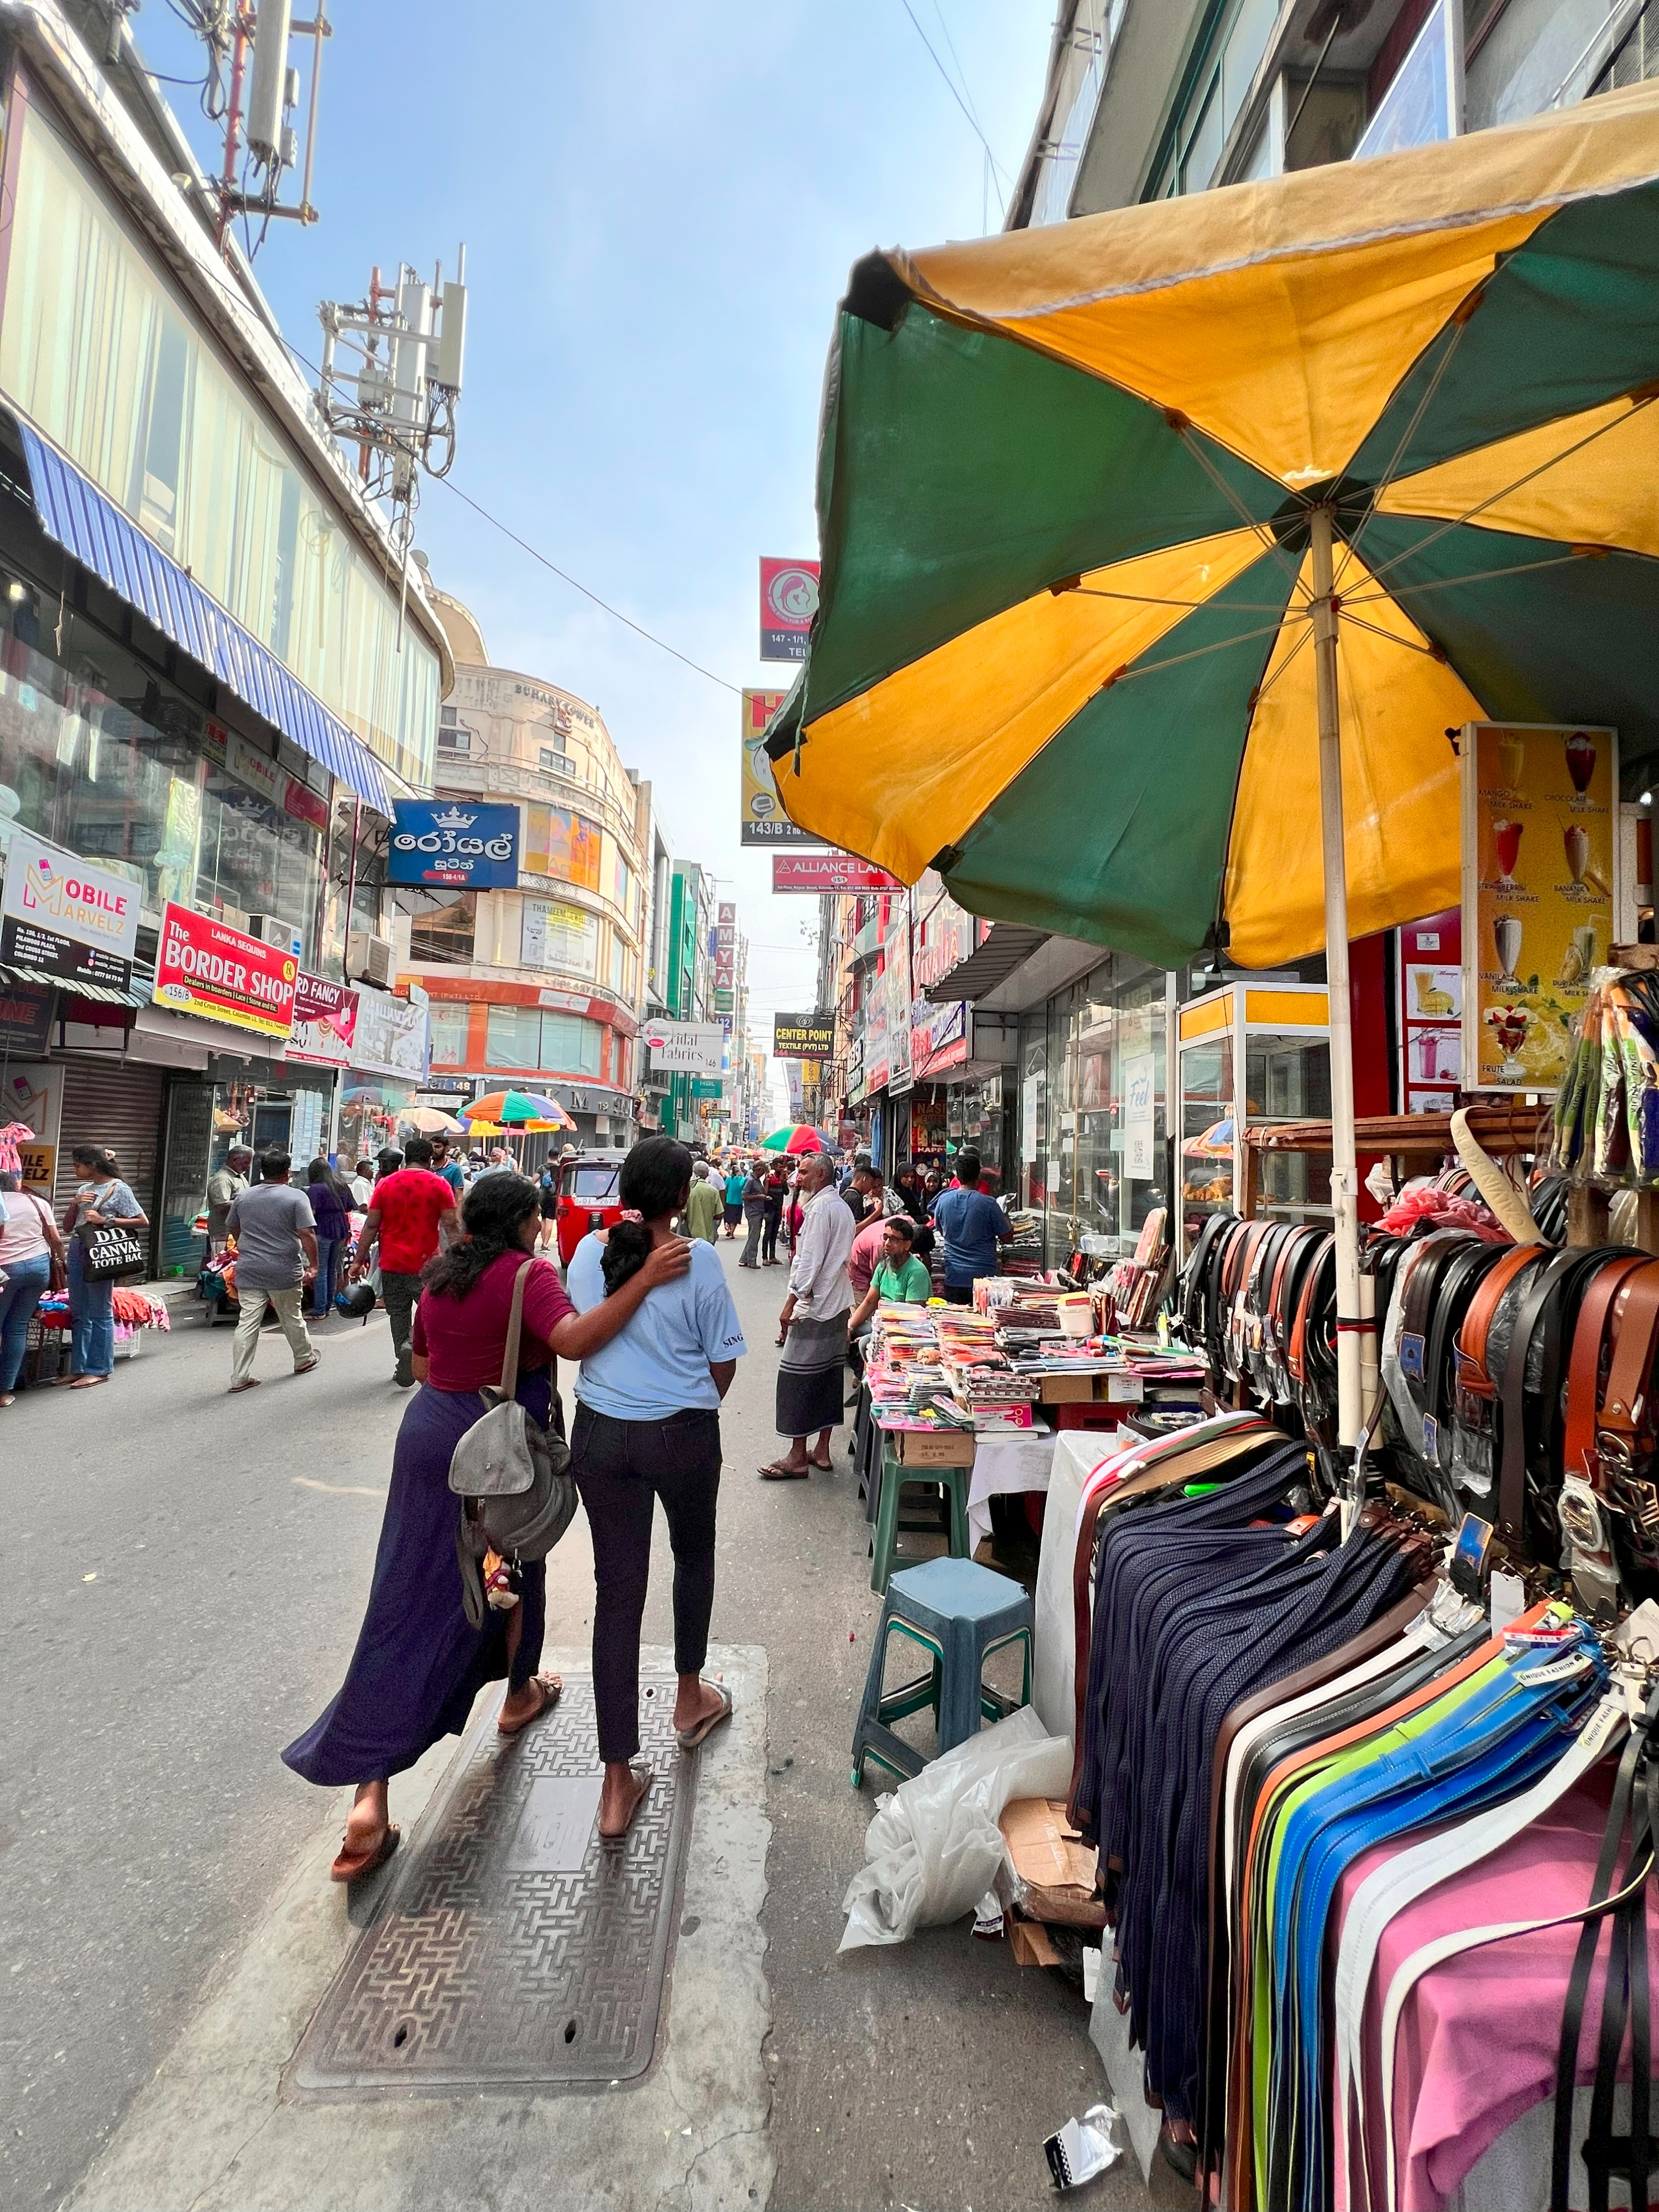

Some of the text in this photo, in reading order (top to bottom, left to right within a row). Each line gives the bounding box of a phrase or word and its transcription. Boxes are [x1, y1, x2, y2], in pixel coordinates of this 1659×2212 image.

[771, 634, 785, 643] 147
[515, 684, 562, 709] BUHARY
[562, 702, 594, 729] TOWER
[1478, 789, 1510, 797] MANGO
[1544, 794, 1587, 802] CHOCOLATE
[749, 823, 783, 834] 143/B
[787, 826, 791, 834] 2
[394, 830, 513, 860] රෝයල්
[792, 862, 855, 874] ALLIANCE
[532, 904, 566, 917] THAMEEM
[169, 920, 190, 942] The
[211, 928, 267, 959] LANKA SEQUINS
[165, 938, 294, 1005] BORDER SHOP
[169, 986, 189, 1000] 156/B
[184, 975, 205, 989] Dealers
[211, 985, 233, 998] boarders
[236, 993, 246, 1001] Lace
[311, 982, 341, 1004] FANCY
[1491, 985, 1538, 994] MILK SHAKE
[204, 1002, 216, 1011] Cross
[671, 1033, 697, 1046] ridal
[776, 1028, 833, 1041] CENTER POINT
[802, 1043, 817, 1051] (PVT)
[706, 1058, 716, 1067] 146
[1579, 1055, 1590, 1082] YING
[1629, 1054, 1638, 1077] YING
[452, 1082, 470, 1091] 148
[1496, 1078, 1522, 1086] SALAD
[94, 1228, 128, 1243] DIY
[89, 1240, 142, 1260] CANVAS
[92, 1256, 122, 1269] TOTE
[723, 1333, 743, 1348] SING
[1520, 1661, 1575, 1681] UNIQUE FASHION
[1585, 1721, 1602, 1746] UNIQUE
